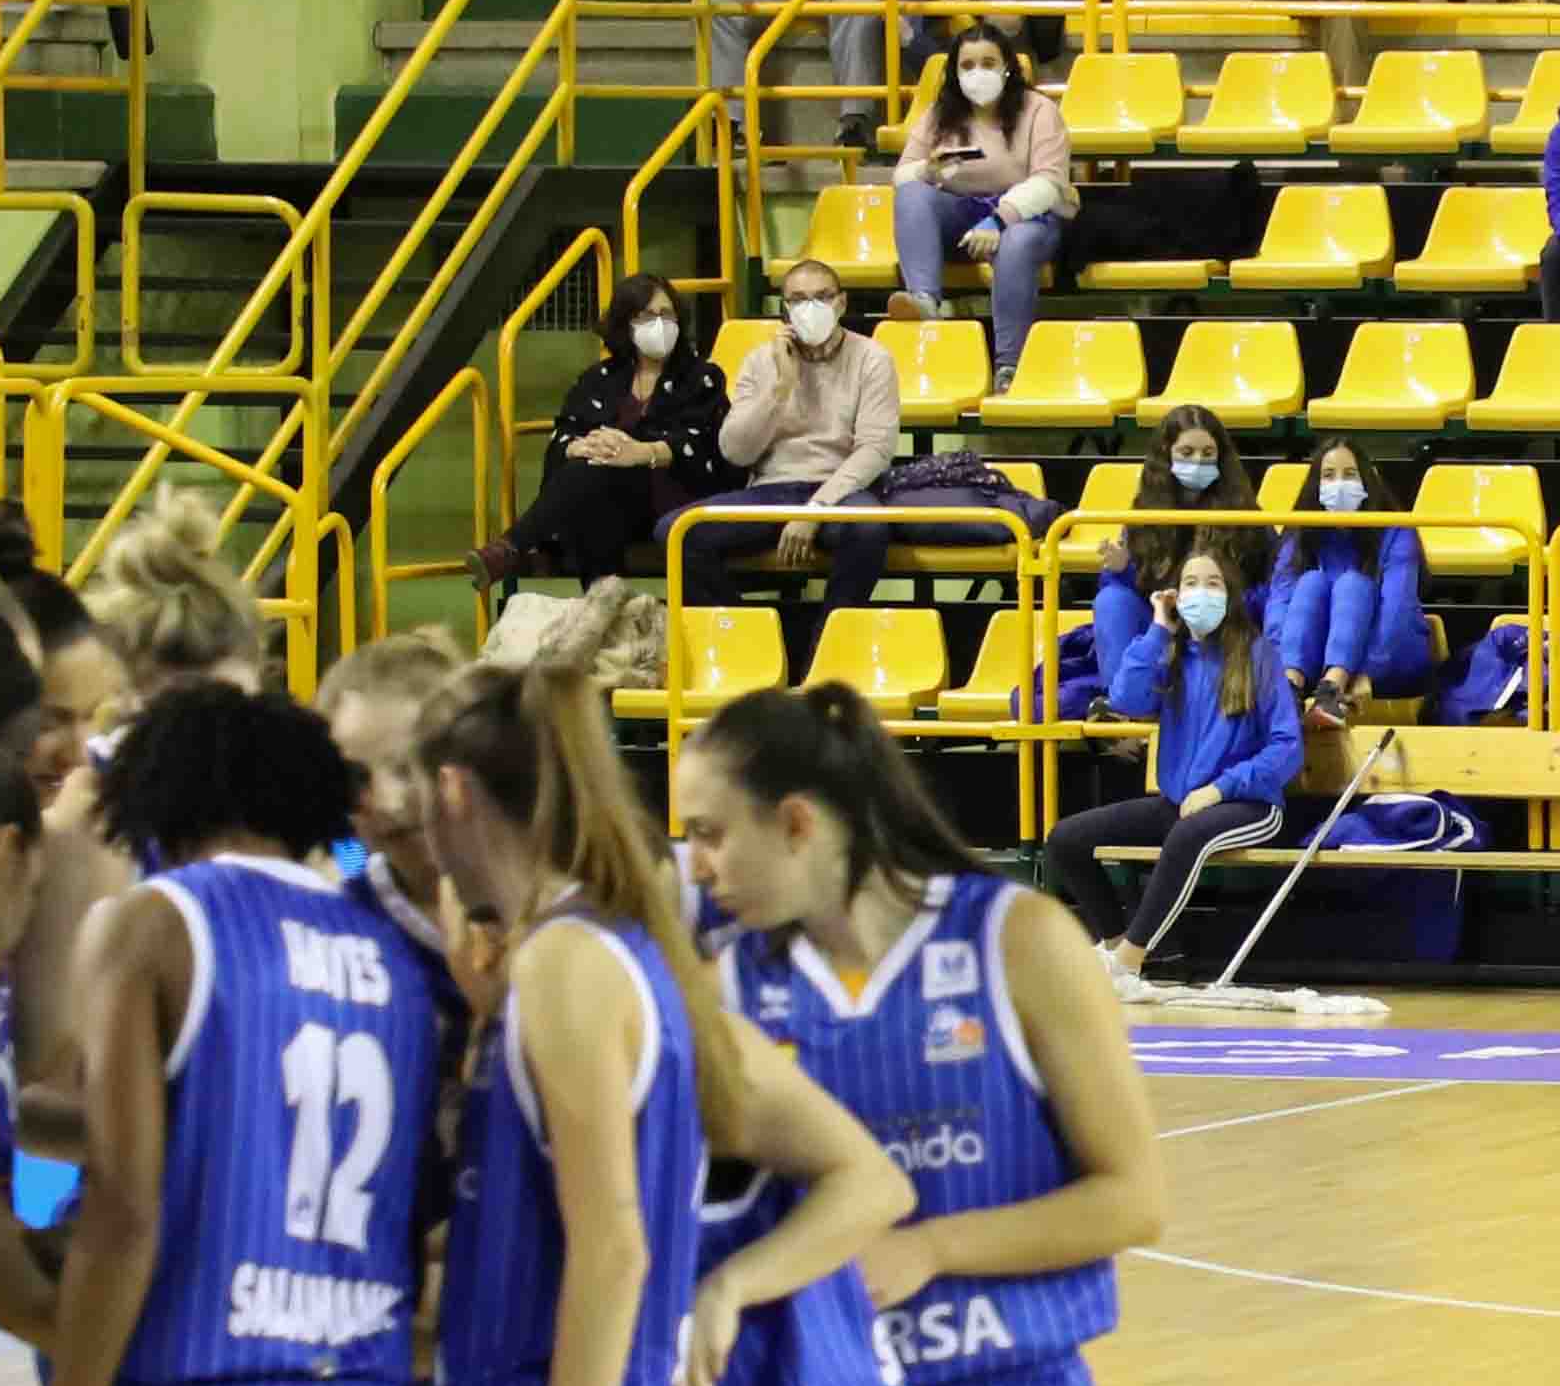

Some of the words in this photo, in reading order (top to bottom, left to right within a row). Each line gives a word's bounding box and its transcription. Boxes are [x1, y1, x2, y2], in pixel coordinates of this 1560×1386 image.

[282, 1021, 395, 1253] 12
[885, 1123, 984, 1173] nida
[893, 1295, 1013, 1364] RSA
